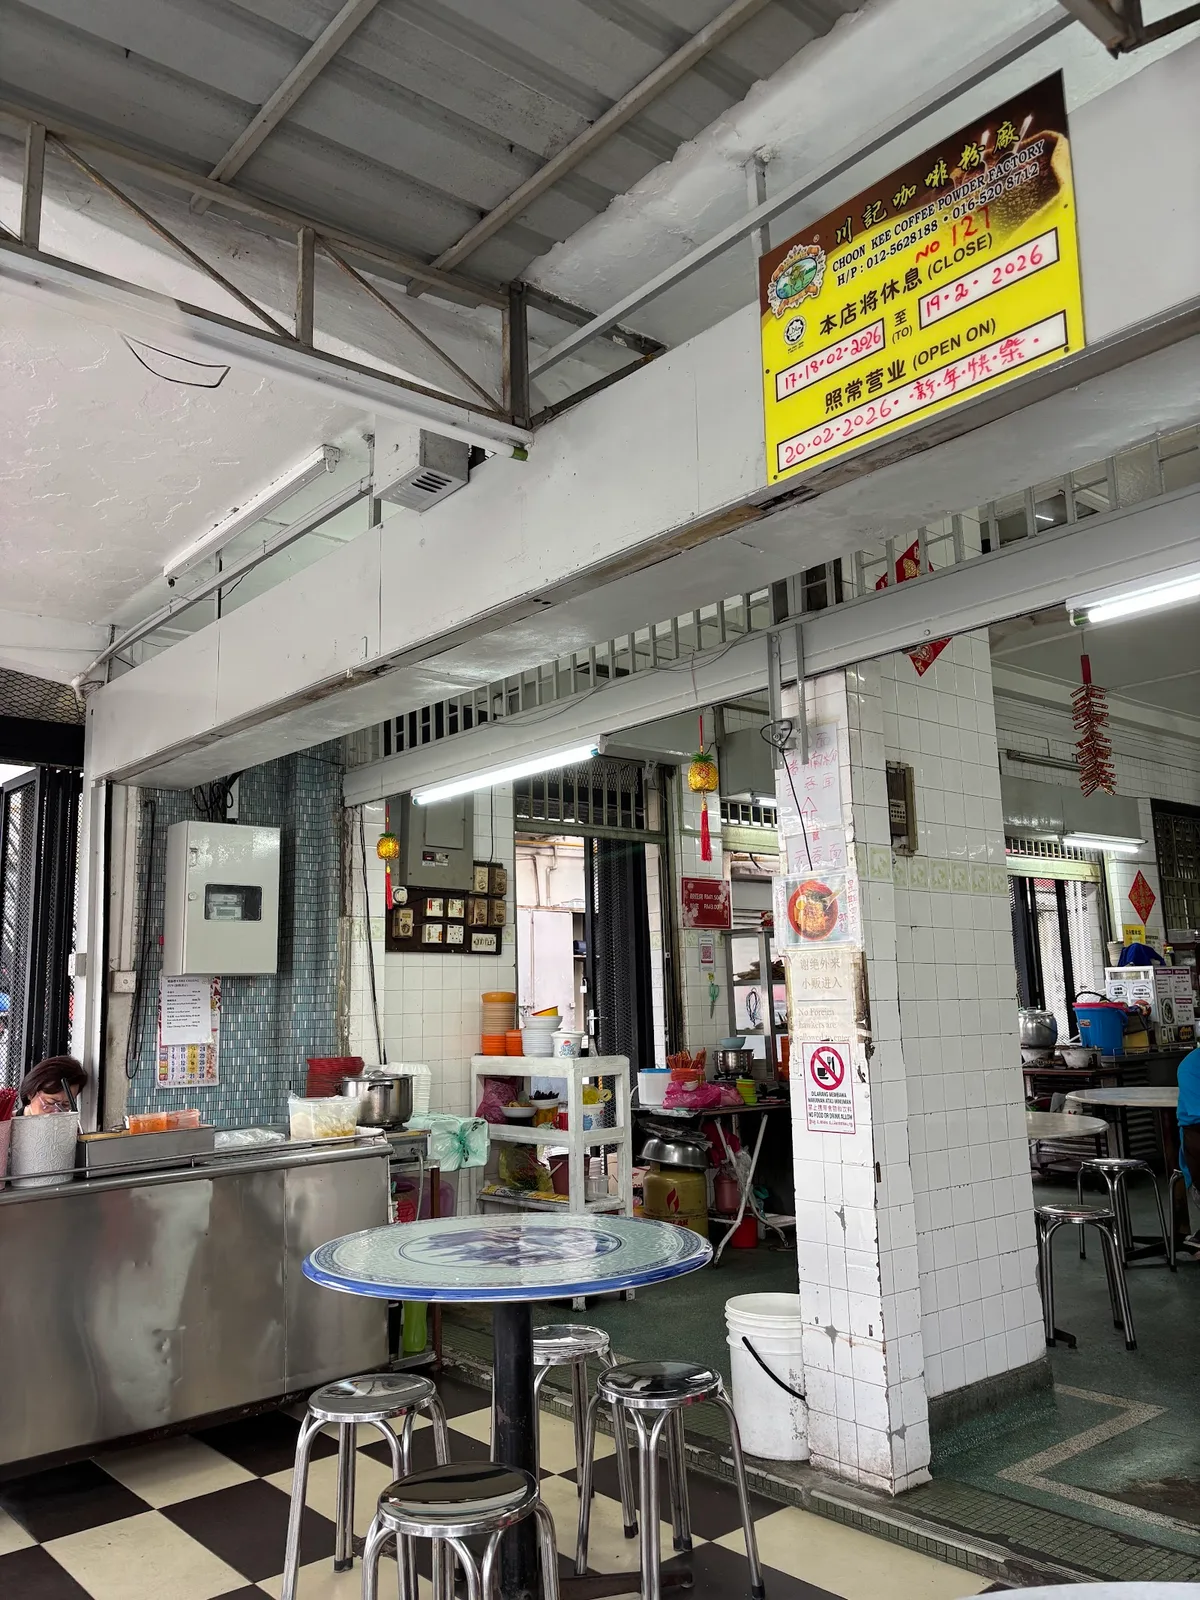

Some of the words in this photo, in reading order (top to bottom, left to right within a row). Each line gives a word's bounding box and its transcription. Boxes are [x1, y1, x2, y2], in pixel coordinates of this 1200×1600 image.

[832, 245, 866, 273] CHOON
[870, 230, 892, 250] KEE
[894, 203, 935, 236] COFFEE
[938, 176, 985, 210] POWDER
[987, 140, 1045, 182] FACTORY
[835, 121, 1020, 244] 川記咖啡粉廠
[866, 219, 938, 269] 012-5628188
[952, 184, 1003, 220] 016-520
[1006, 162, 1040, 190] 8712
[915, 240, 940, 264] NO
[820, 267, 923, 336] 本店将休息
[928, 232, 993, 280] (CLOSE)
[892, 325, 913, 344] (TO)
[894, 308, 907, 327] 至
[825, 359, 907, 414] 照常营业
[912, 335, 961, 372] (OPEN
[966, 318, 996, 342] ON)
[800, 958, 841, 970] 谢绝外来
[801, 976, 842, 990] 小贩进入
